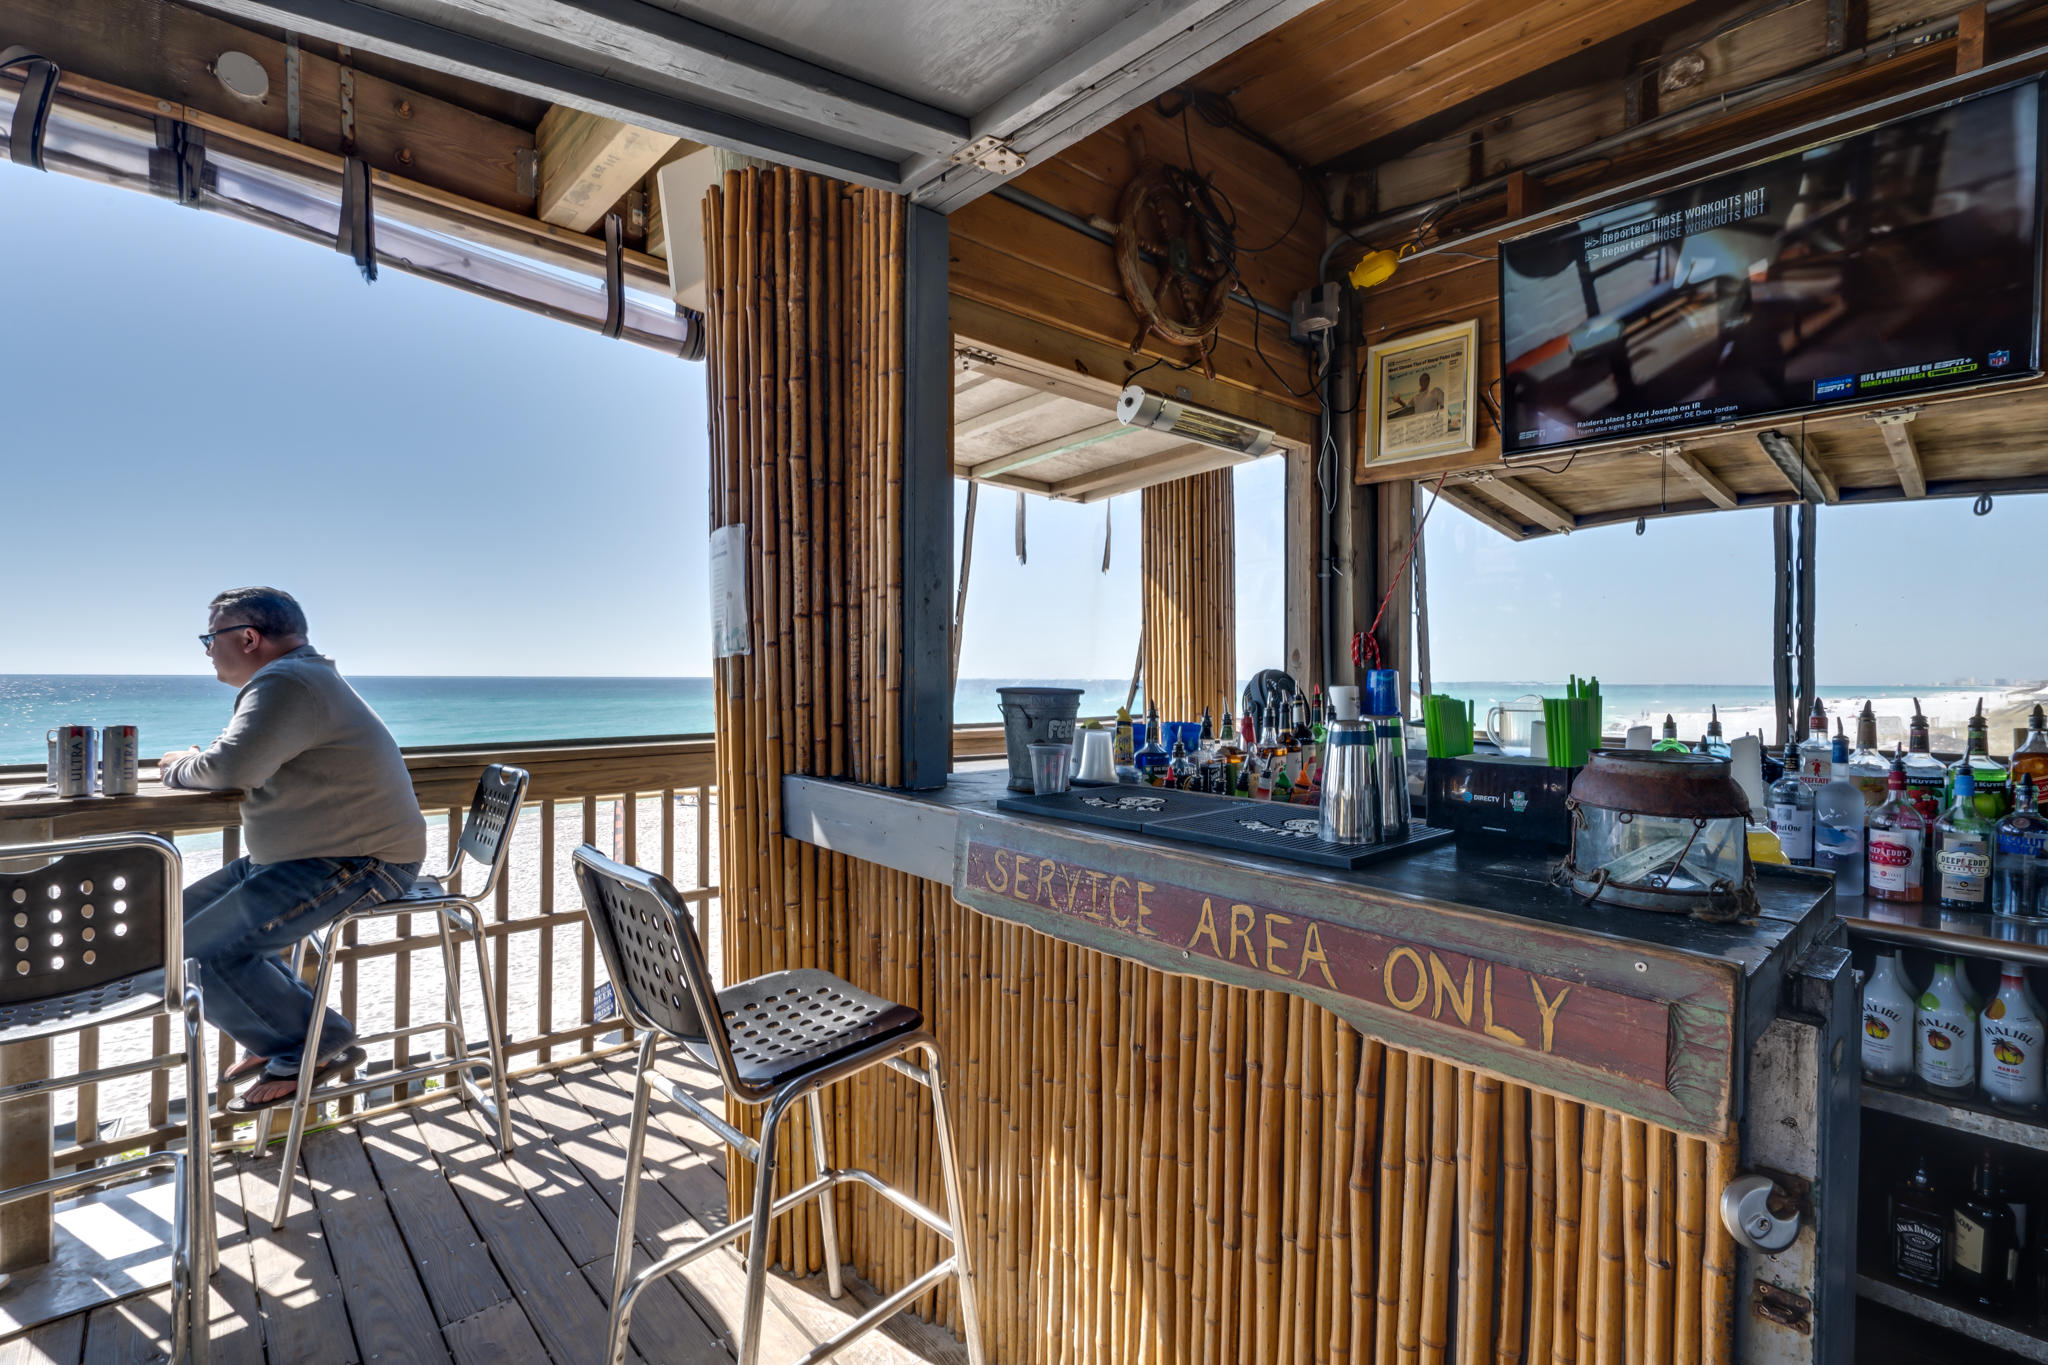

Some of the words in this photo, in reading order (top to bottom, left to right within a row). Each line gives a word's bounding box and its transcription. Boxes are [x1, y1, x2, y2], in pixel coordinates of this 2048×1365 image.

[1652, 212, 1682, 229] THOSE
[1685, 195, 1741, 219] WORKOUTS
[1745, 187, 1766, 203] NOT
[1652, 228, 1682, 243] THOSE
[1685, 210, 1741, 234] WORKOUTS
[1744, 203, 1765, 219] NOT
[1577, 418, 1604, 429] Raiders
[1605, 415, 1625, 426] place
[1626, 413, 1632, 421] S
[1633, 410, 1649, 419] Karl
[1650, 405, 1678, 417] Joseph
[1679, 404, 1690, 412] on
[1684, 411, 1695, 419] DE
[1713, 404, 1738, 414] Jordan
[1519, 429, 1546, 440] ESPN
[71, 741, 83, 782] ULTRA
[123, 742, 134, 780] ULTRA
[1473, 794, 1500, 803] DIRECTV
[1887, 849, 1907, 857] EDDY
[1941, 856, 1960, 865] DEEP
[985, 849, 1159, 936] SERVICE
[1187, 897, 1338, 990] AREA
[1383, 947, 1573, 1053] ONLY
[1918, 1019, 1967, 1040] MALIBU
[1985, 1027, 2037, 1047] MALIBU
[1896, 1223, 1914, 1232] JACK
